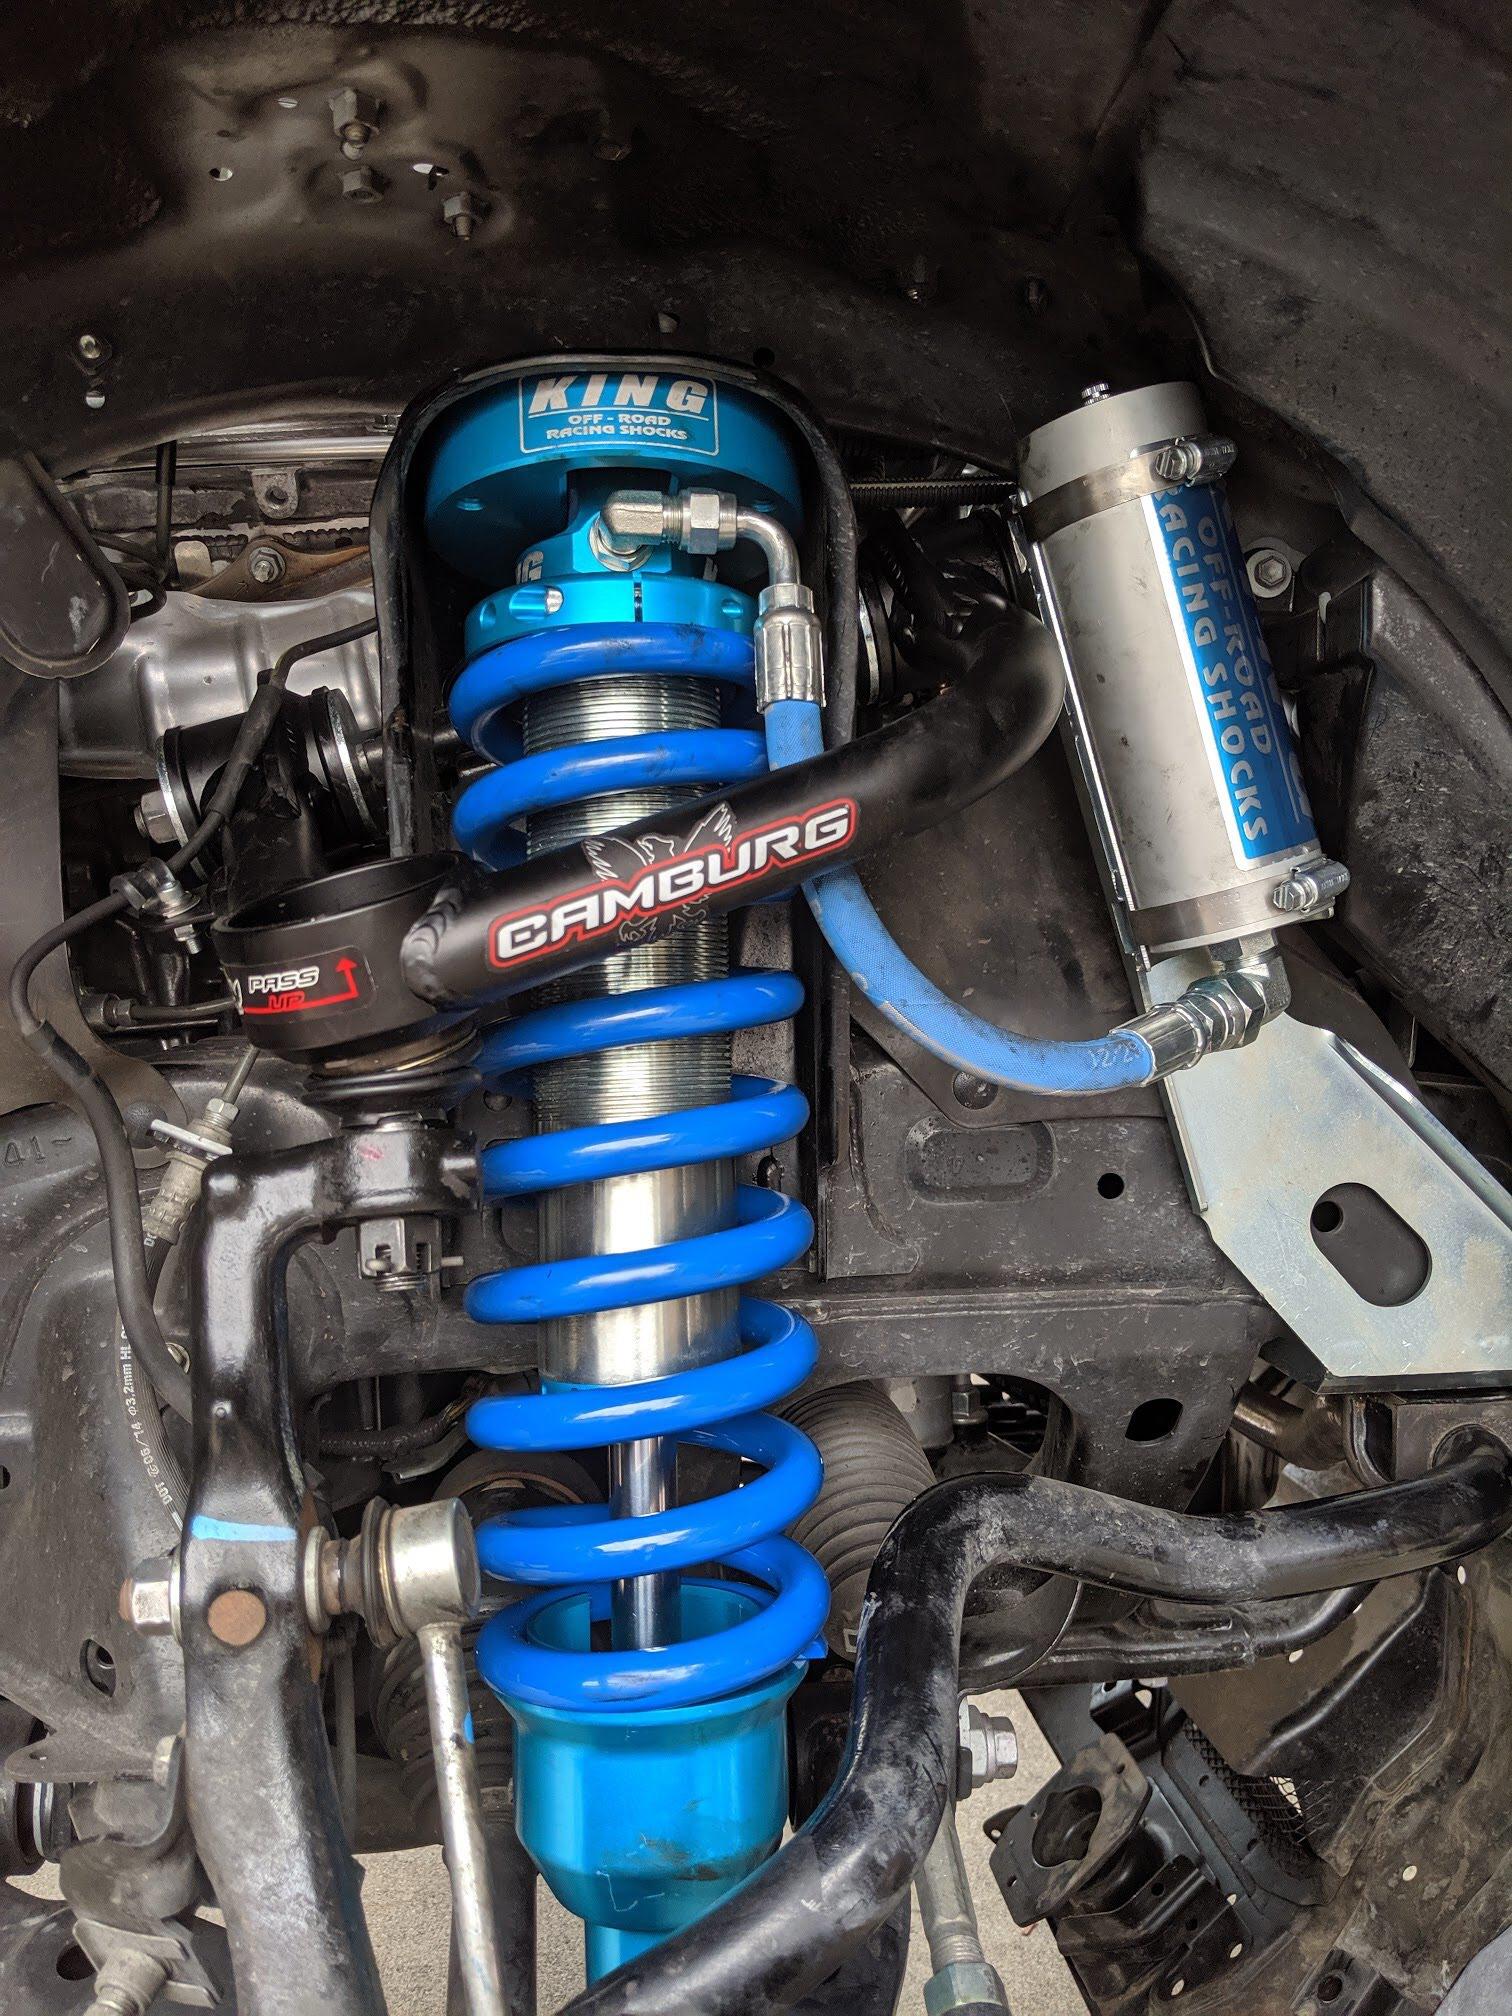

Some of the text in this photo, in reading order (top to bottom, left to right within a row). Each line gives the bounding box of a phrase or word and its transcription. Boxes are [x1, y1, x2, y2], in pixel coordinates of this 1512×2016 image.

[528, 373, 709, 415] KING
[546, 425, 688, 441] RACING SHOCKS
[1198, 516, 1273, 755] OFF-ROAD
[1203, 662, 1268, 840] SHOCKS
[496, 804, 850, 960] CAMBURG
[248, 965, 320, 995] PASS
[267, 990, 306, 1011] UP
[154, 1482, 173, 1505] DOT
